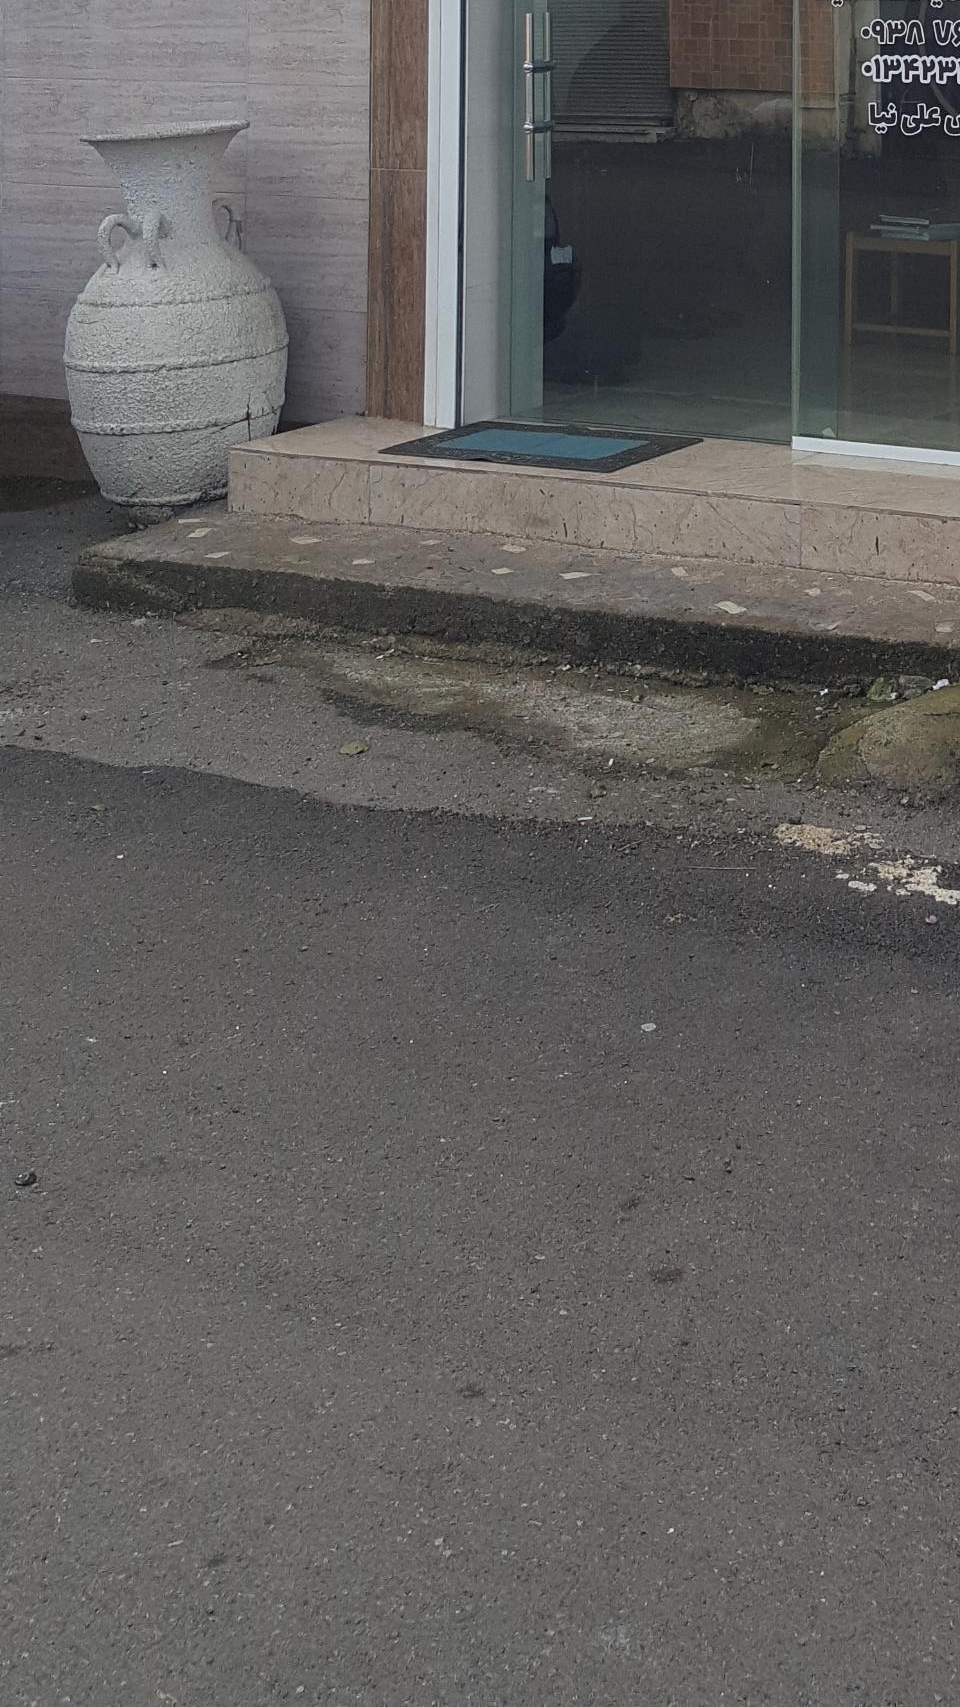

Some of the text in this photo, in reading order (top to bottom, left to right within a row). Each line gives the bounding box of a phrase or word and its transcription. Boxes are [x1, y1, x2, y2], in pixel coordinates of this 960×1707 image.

[860, 19, 926, 46] ۰۹۳۸
[868, 102, 898, 134] نیا
[901, 103, 941, 136] علی
